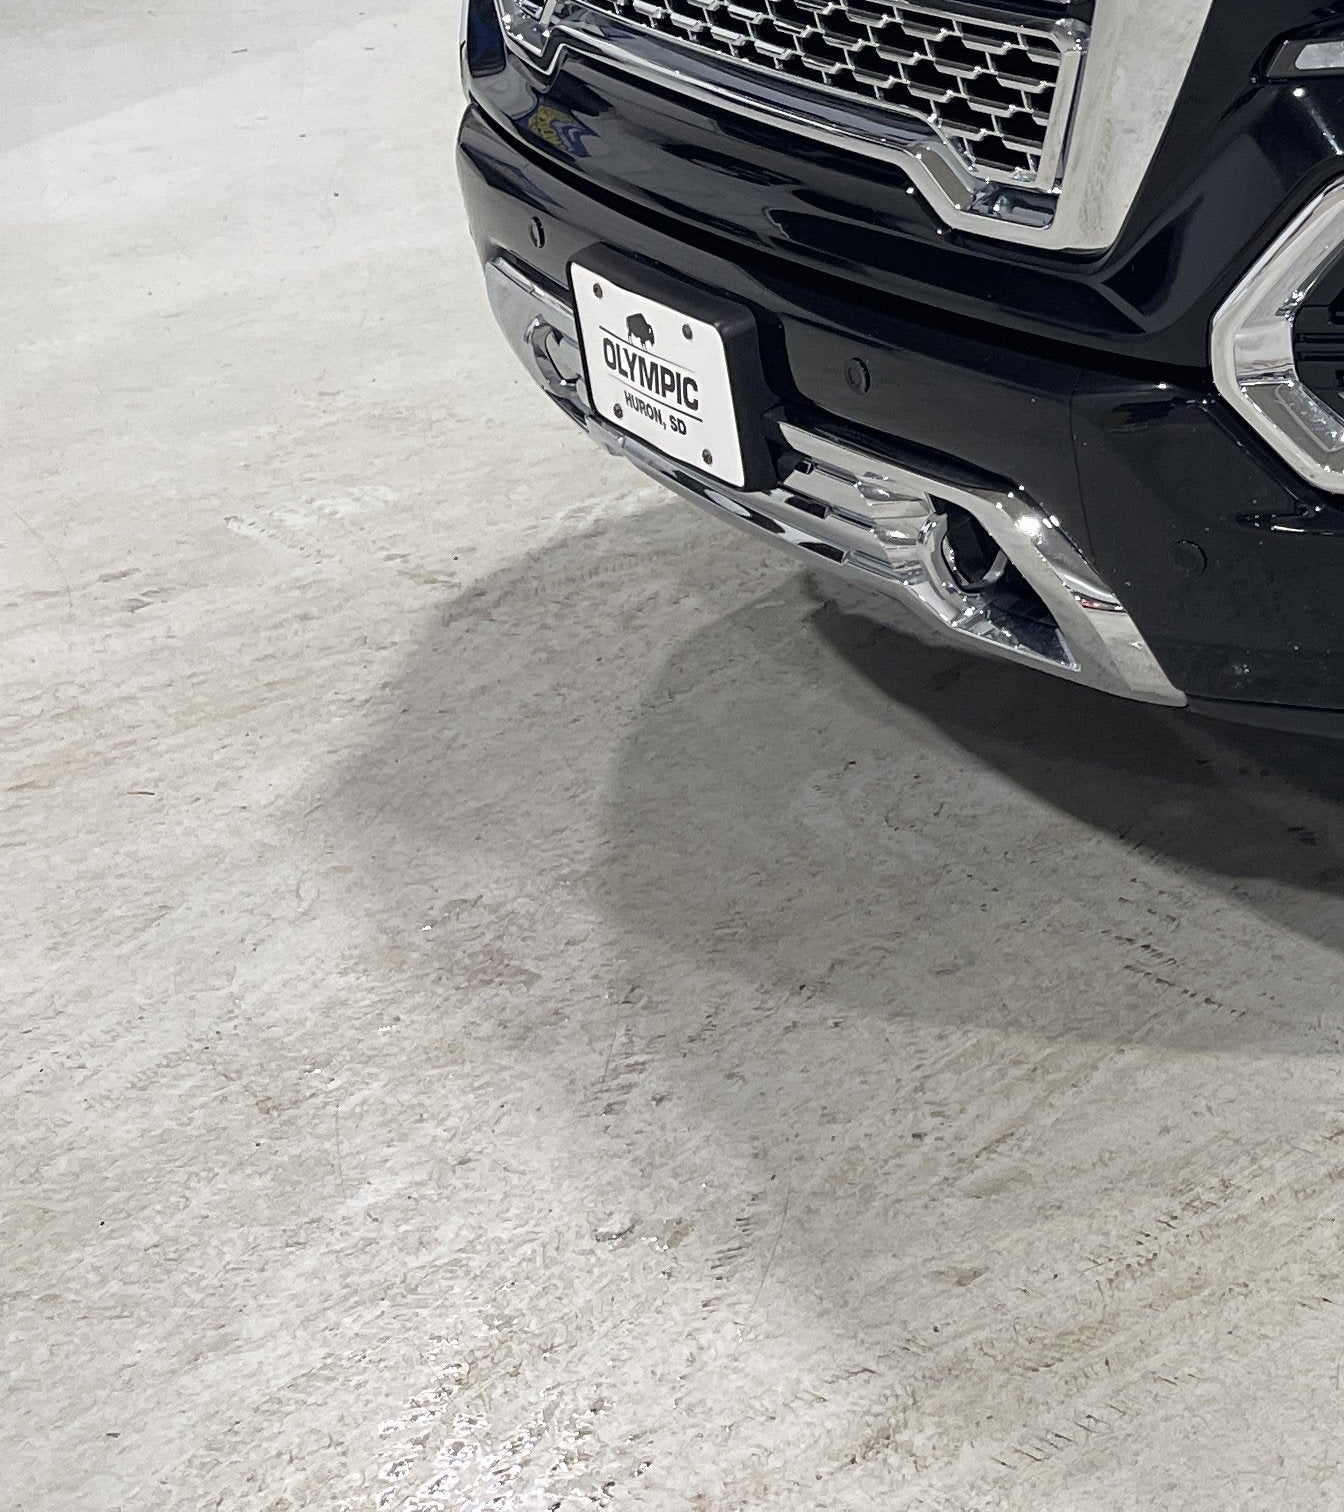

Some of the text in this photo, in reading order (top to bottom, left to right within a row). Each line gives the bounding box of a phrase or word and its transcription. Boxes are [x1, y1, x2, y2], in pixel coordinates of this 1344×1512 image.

[603, 337, 699, 411] OLYMPIC
[624, 390, 687, 436] HURON, SD
